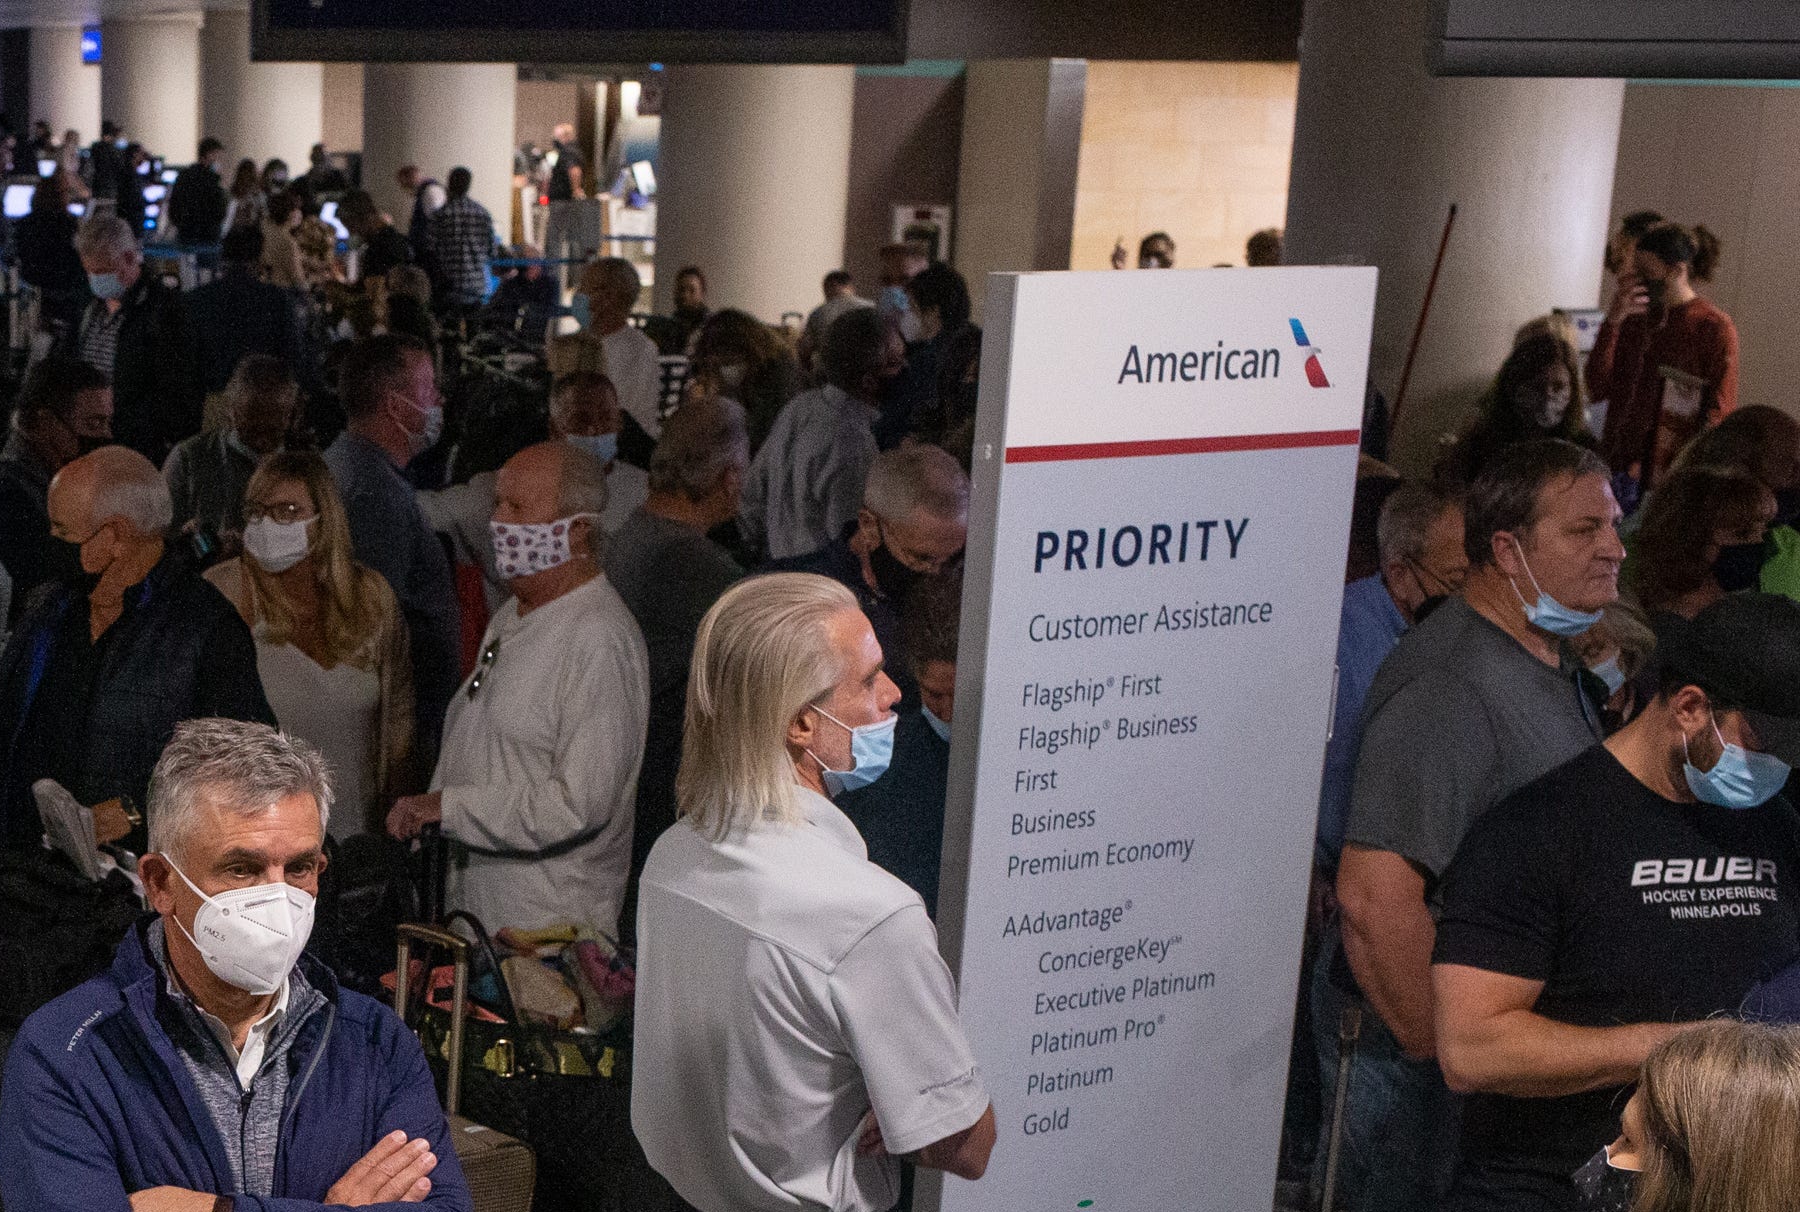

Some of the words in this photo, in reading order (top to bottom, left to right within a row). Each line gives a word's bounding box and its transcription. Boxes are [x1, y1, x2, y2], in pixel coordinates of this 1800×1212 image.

[1118, 341, 1280, 385] American
[1034, 518, 1250, 573] PRIORITY
[1029, 609, 1148, 642] Customer
[1155, 599, 1273, 633] Assistance
[1121, 674, 1162, 698] First
[1117, 713, 1198, 739] Business
[1015, 769, 1058, 792] First
[1011, 807, 1096, 834] Business
[1008, 849, 1099, 878] Premium
[1106, 836, 1194, 866] Economy
[1631, 856, 1778, 886] BAUER
[1643, 889, 1696, 904] HOCKEY
[1701, 887, 1778, 901] EXPERIENCE
[1670, 903, 1762, 920] MINNEAPOLIS
[203, 925, 226, 942] PM2.5
[1035, 984, 1126, 1015] Executive
[1132, 970, 1216, 999] Platinum
[1031, 1023, 1117, 1056] Platinum
[1027, 1065, 1113, 1096] Platinum
[1023, 1108, 1070, 1135] Gold
